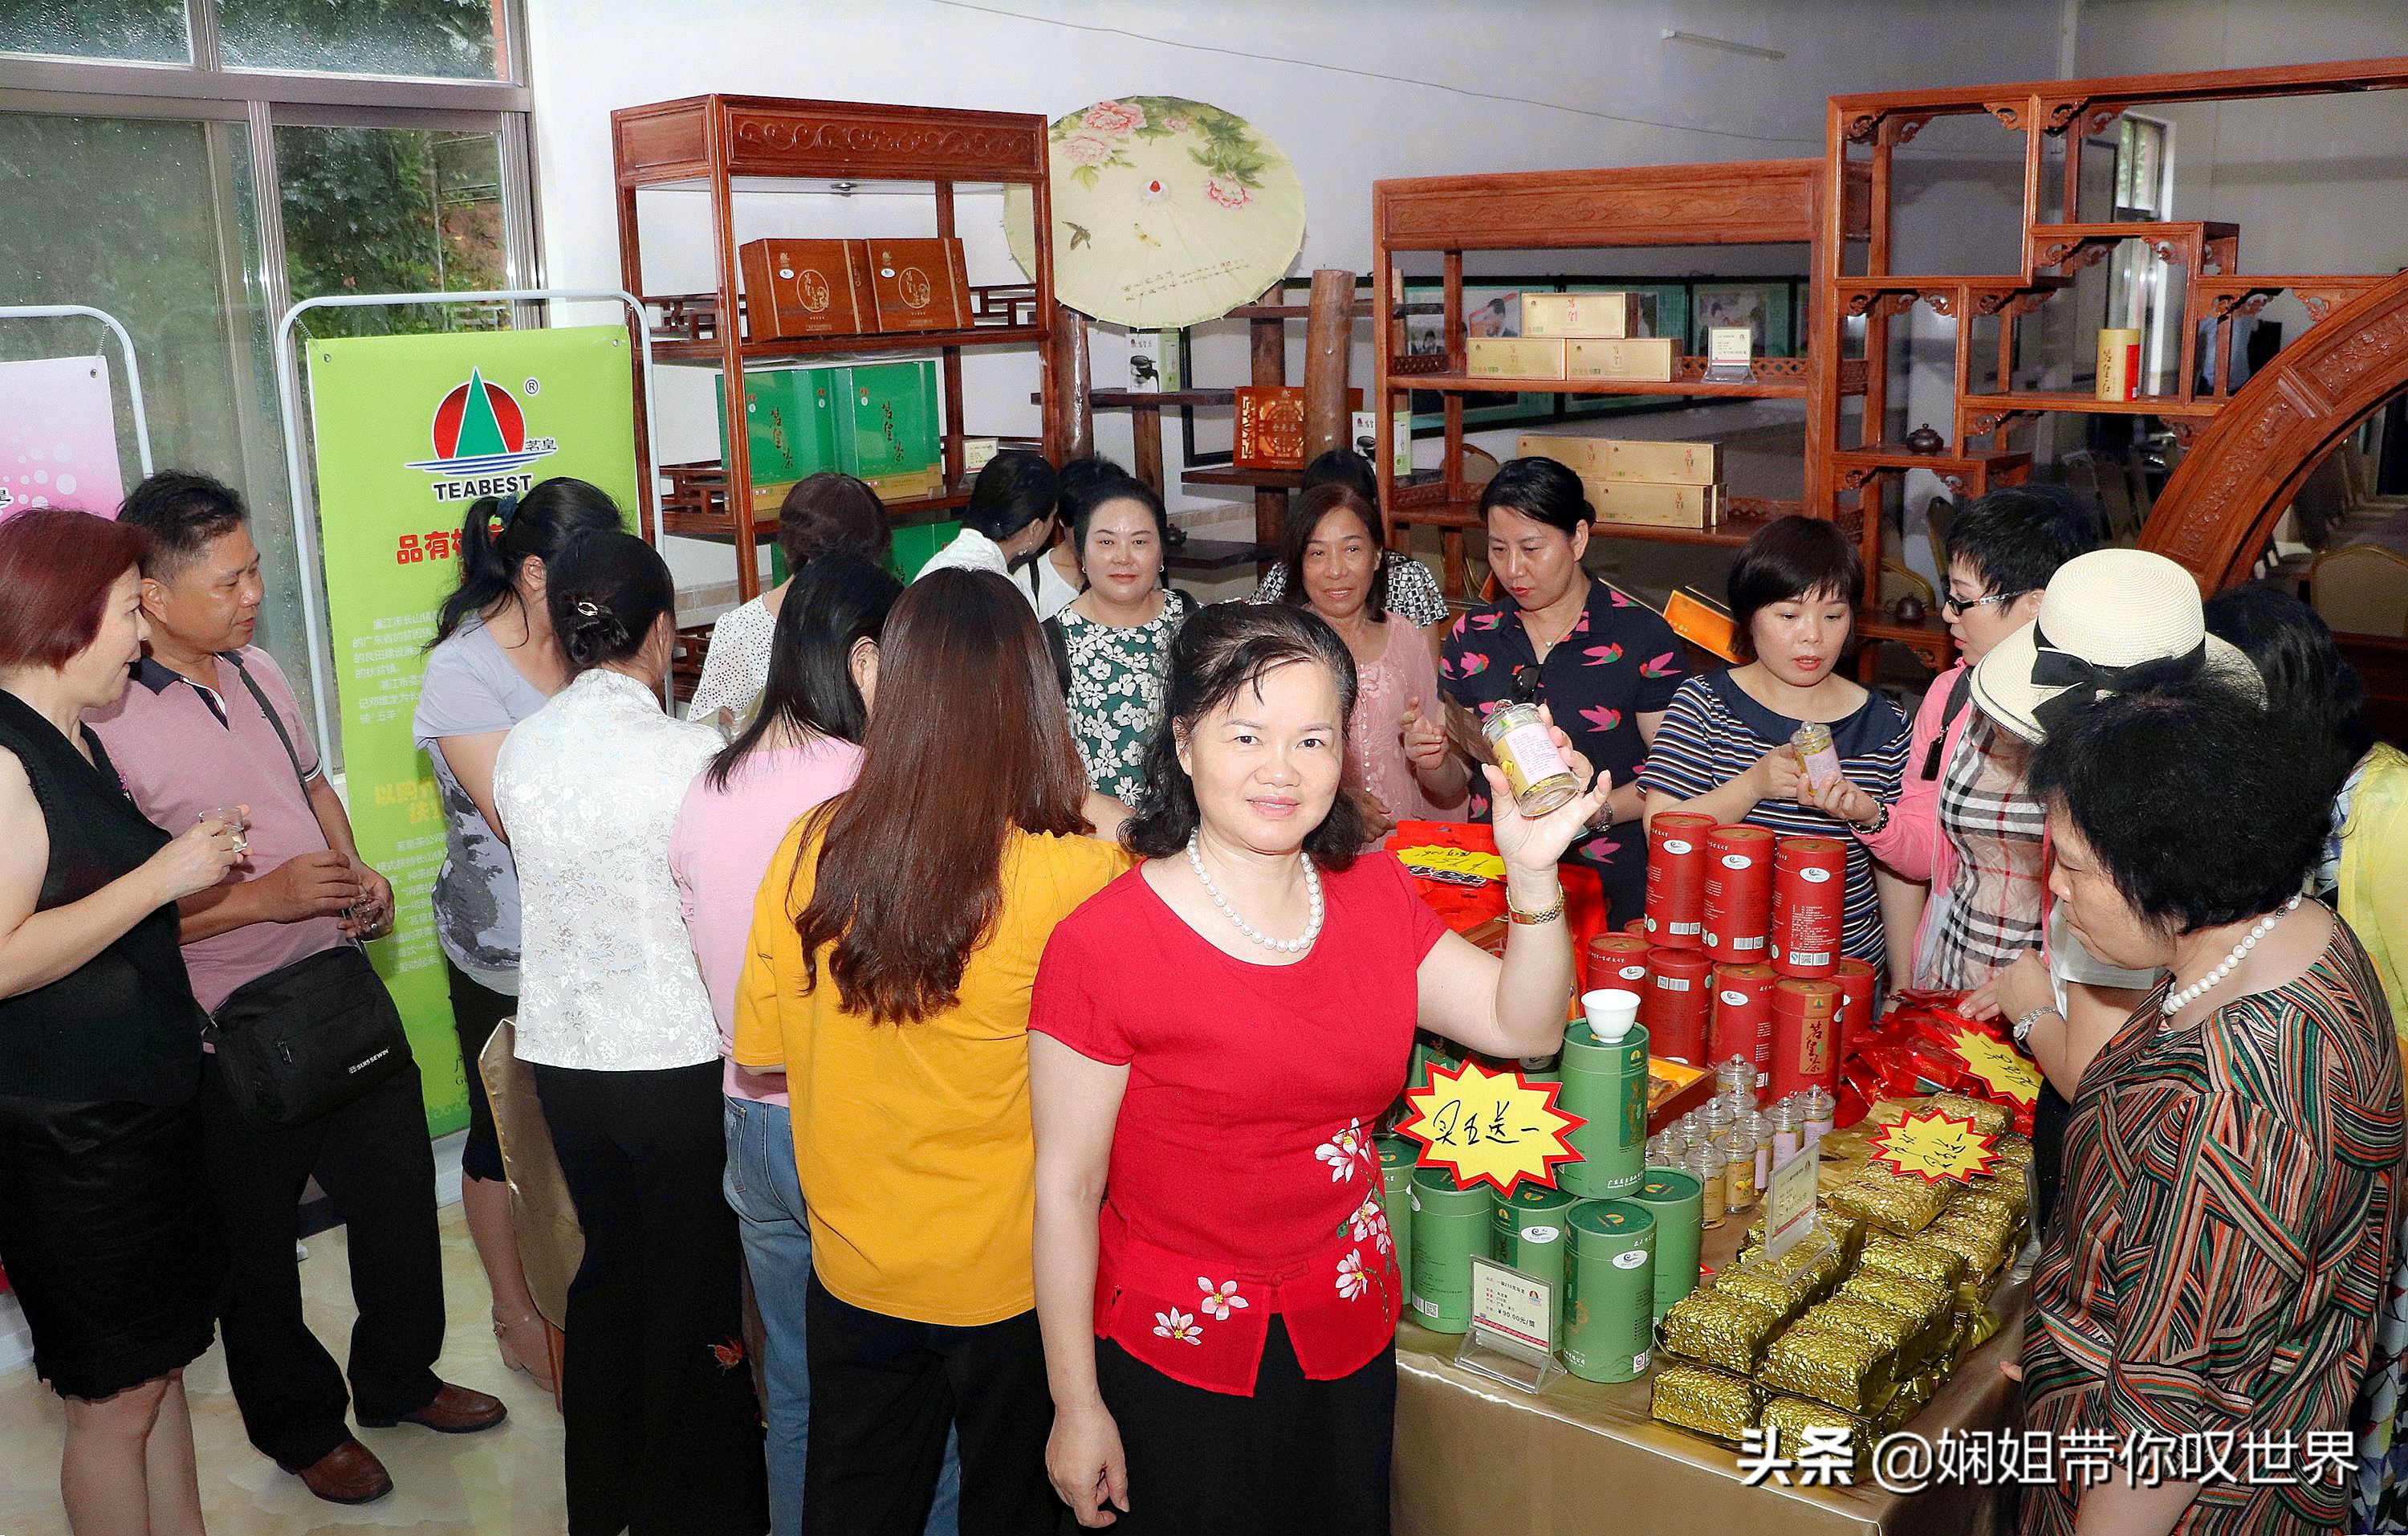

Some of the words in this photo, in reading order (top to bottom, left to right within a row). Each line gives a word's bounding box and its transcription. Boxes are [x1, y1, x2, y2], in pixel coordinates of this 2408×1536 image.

[525, 438, 558, 451] 茗皇
[433, 475, 532, 500] TEABEST
[1805, 1021, 1823, 1073] 茗皇茶
[1434, 1100, 1540, 1146] 买五送一
